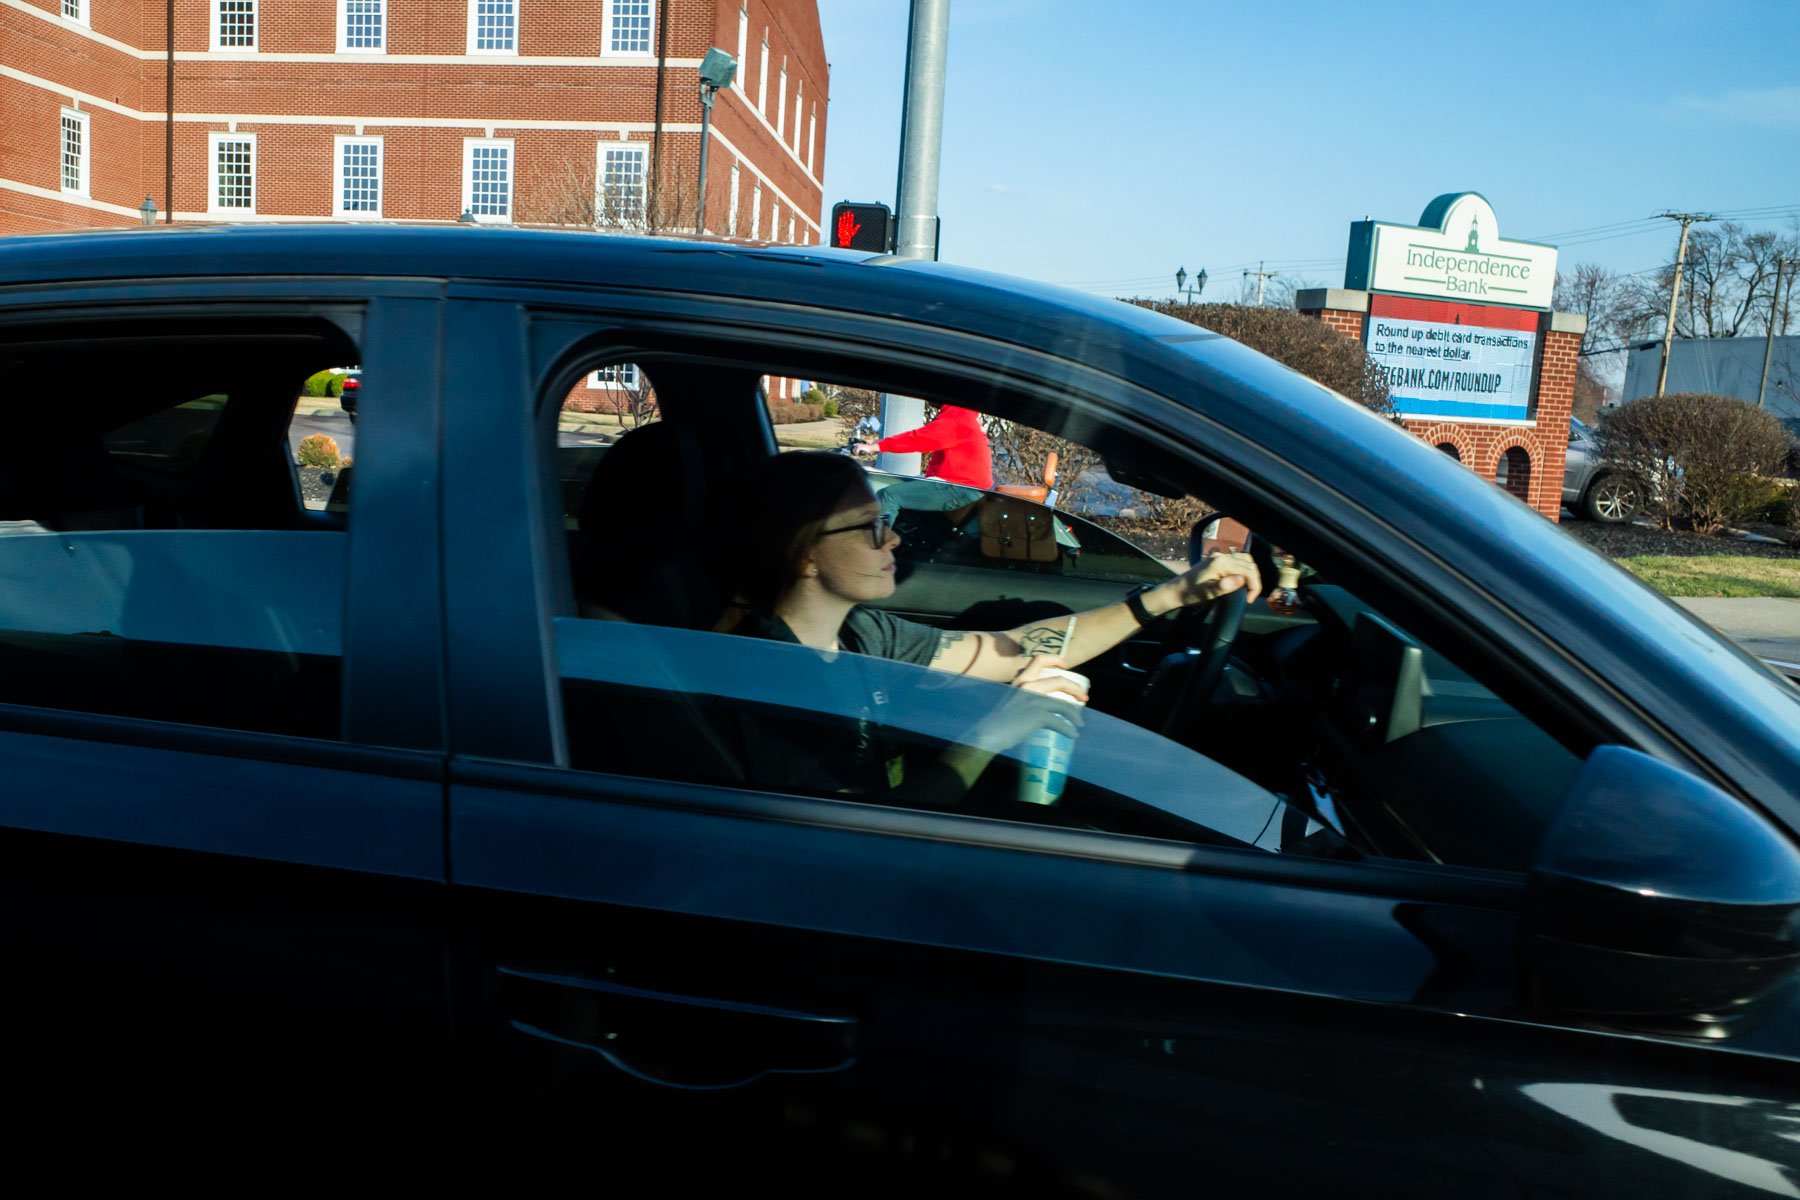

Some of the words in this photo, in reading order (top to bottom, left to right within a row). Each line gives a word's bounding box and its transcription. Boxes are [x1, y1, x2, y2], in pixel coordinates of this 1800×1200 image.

[1406, 248, 1531, 280] Independence
[1445, 275, 1488, 295] Bank
[1376, 323, 1409, 339] Round
[1411, 329, 1424, 342] up
[1425, 328, 1450, 343] debit
[1451, 331, 1472, 344] card
[1474, 334, 1529, 349] transactions
[1374, 341, 1386, 352] to
[1387, 342, 1403, 354] the
[1405, 345, 1441, 359] nearest
